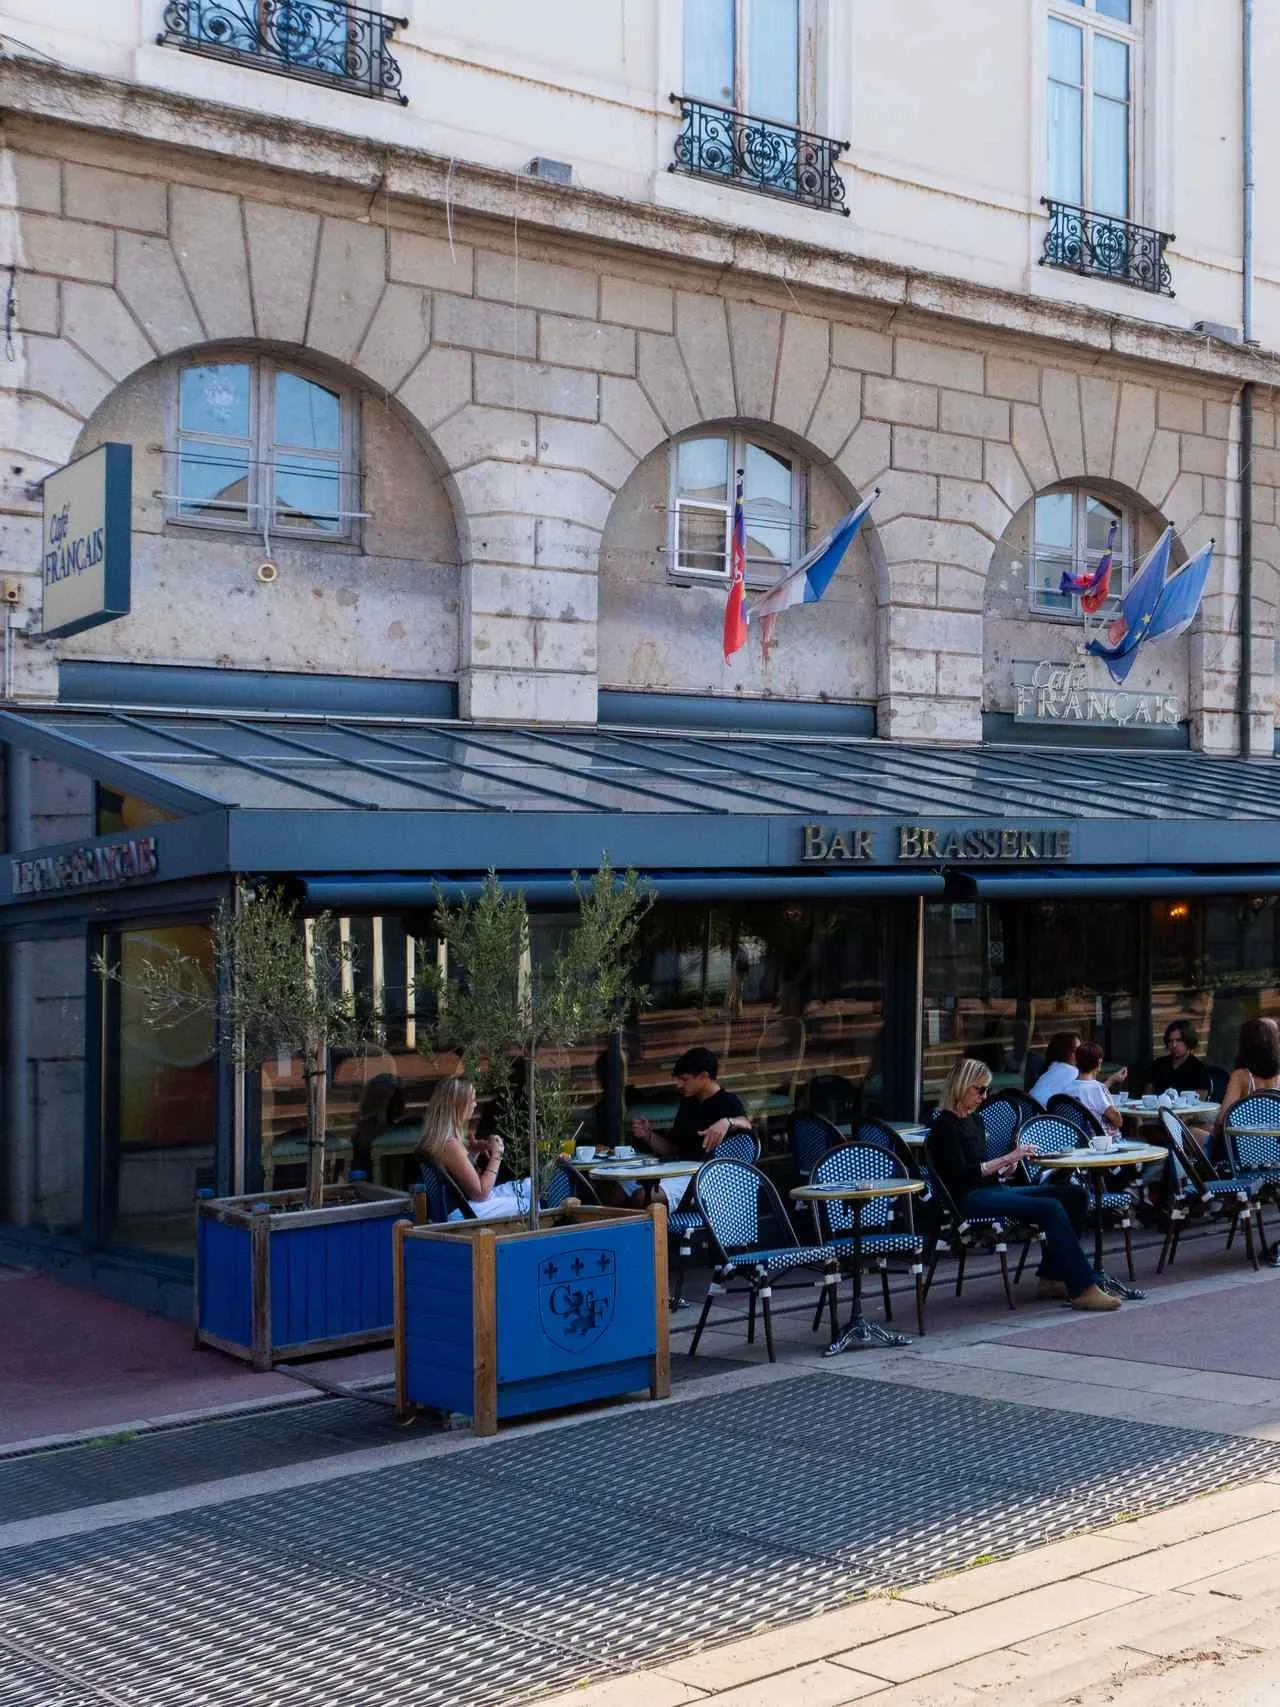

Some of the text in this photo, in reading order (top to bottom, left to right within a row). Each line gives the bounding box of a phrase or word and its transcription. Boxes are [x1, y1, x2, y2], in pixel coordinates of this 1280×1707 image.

[45, 528, 104, 587] FRANÇAIS
[1032, 660, 1087, 701] Café
[1013, 685, 1182, 727] FRANÇAIS
